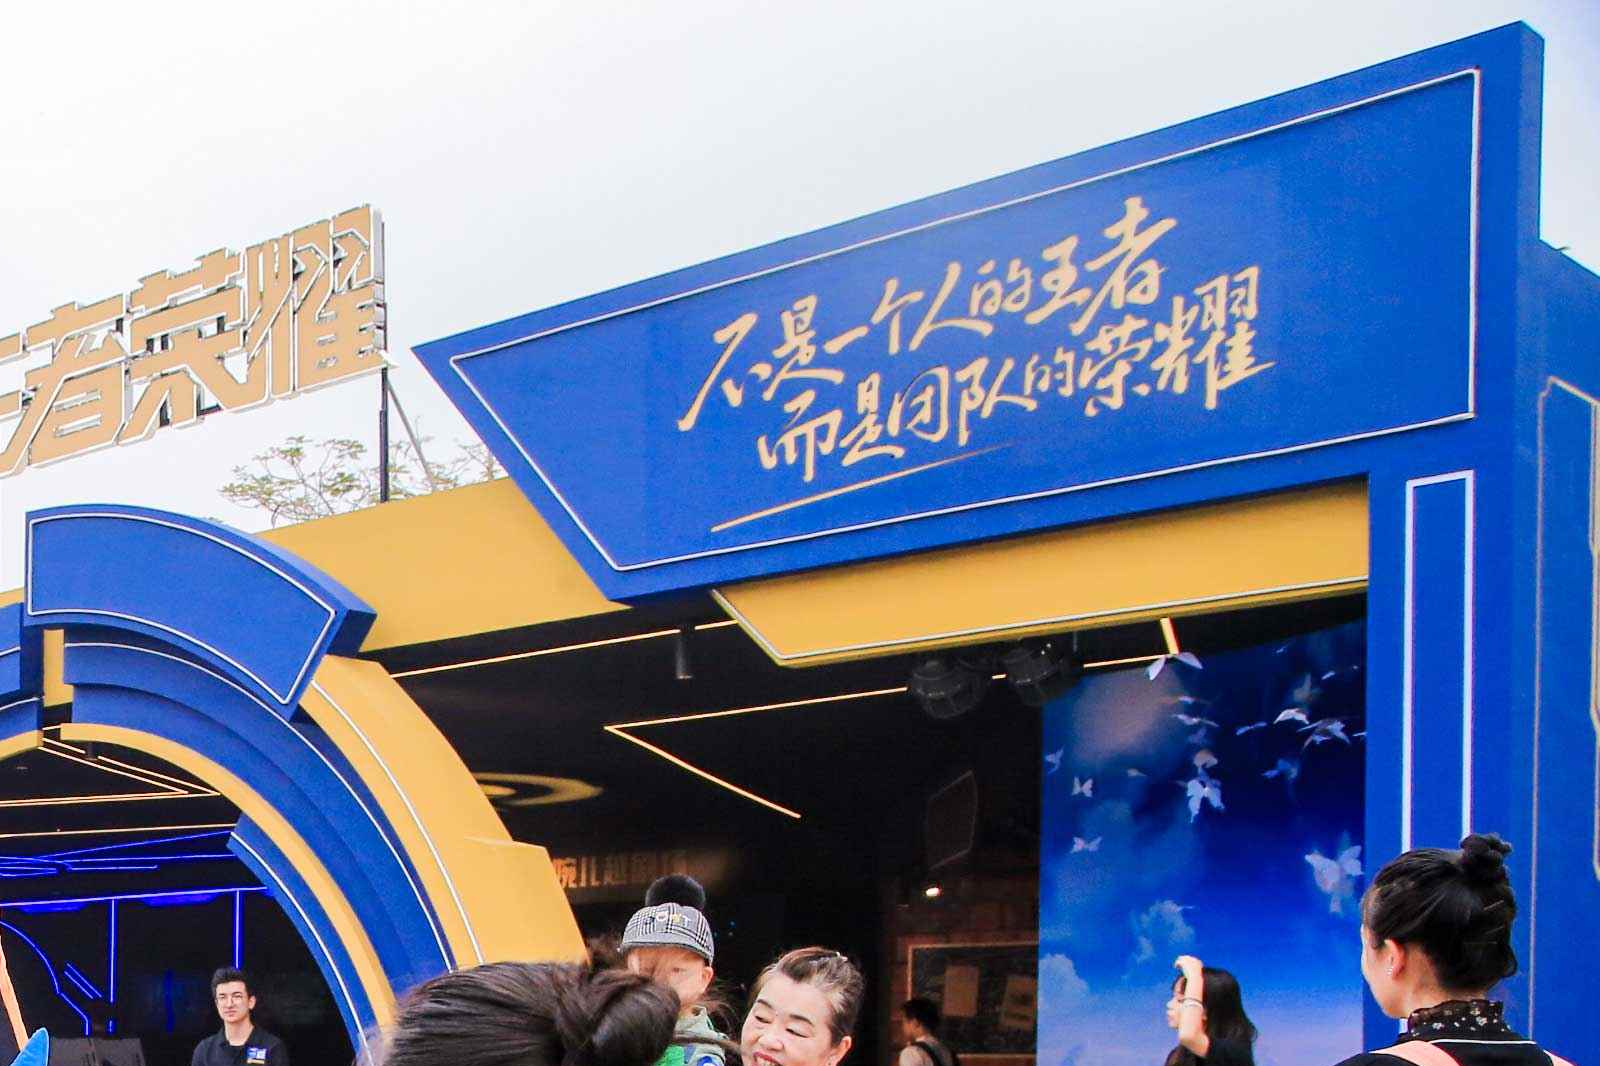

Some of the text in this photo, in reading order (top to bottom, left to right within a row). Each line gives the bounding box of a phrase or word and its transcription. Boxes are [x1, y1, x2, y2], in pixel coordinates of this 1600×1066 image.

[676, 196, 1178, 432] 不是一个人的王者
[756, 264, 1277, 483] 而是团队的荣耀
